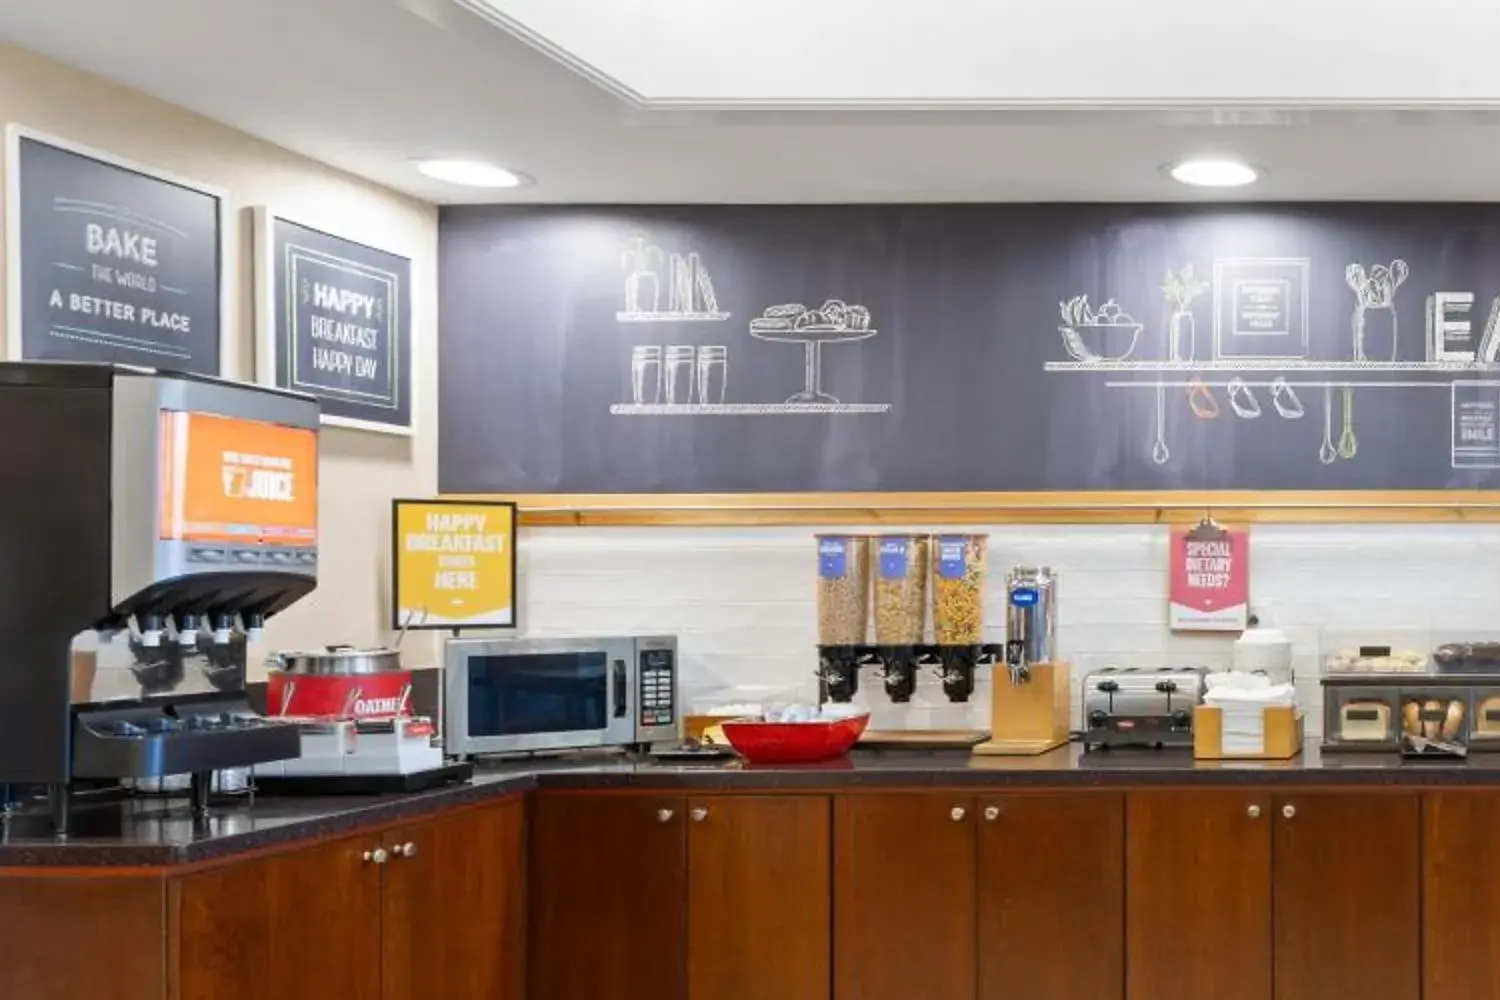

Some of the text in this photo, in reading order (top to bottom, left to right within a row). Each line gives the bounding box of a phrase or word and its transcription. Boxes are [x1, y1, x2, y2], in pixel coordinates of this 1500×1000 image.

[86, 222, 159, 267] BAKE
[91, 263, 156, 293] THE WORLD
[49, 288, 191, 332] A BETTER PLACE
[313, 281, 375, 319] HAPPY
[311, 314, 378, 350] BREAKFAST
[313, 346, 377, 379] HAPPY DAY
[425, 512, 487, 533] HAPPY
[405, 532, 506, 553] BREAKFAST
[1186, 540, 1232, 557] SPECIAL
[1185, 557, 1232, 573] DIETARY
[433, 570, 479, 591] HERE
[1186, 573, 1231, 589] NEEDS?
[354, 697, 404, 716] OATME
